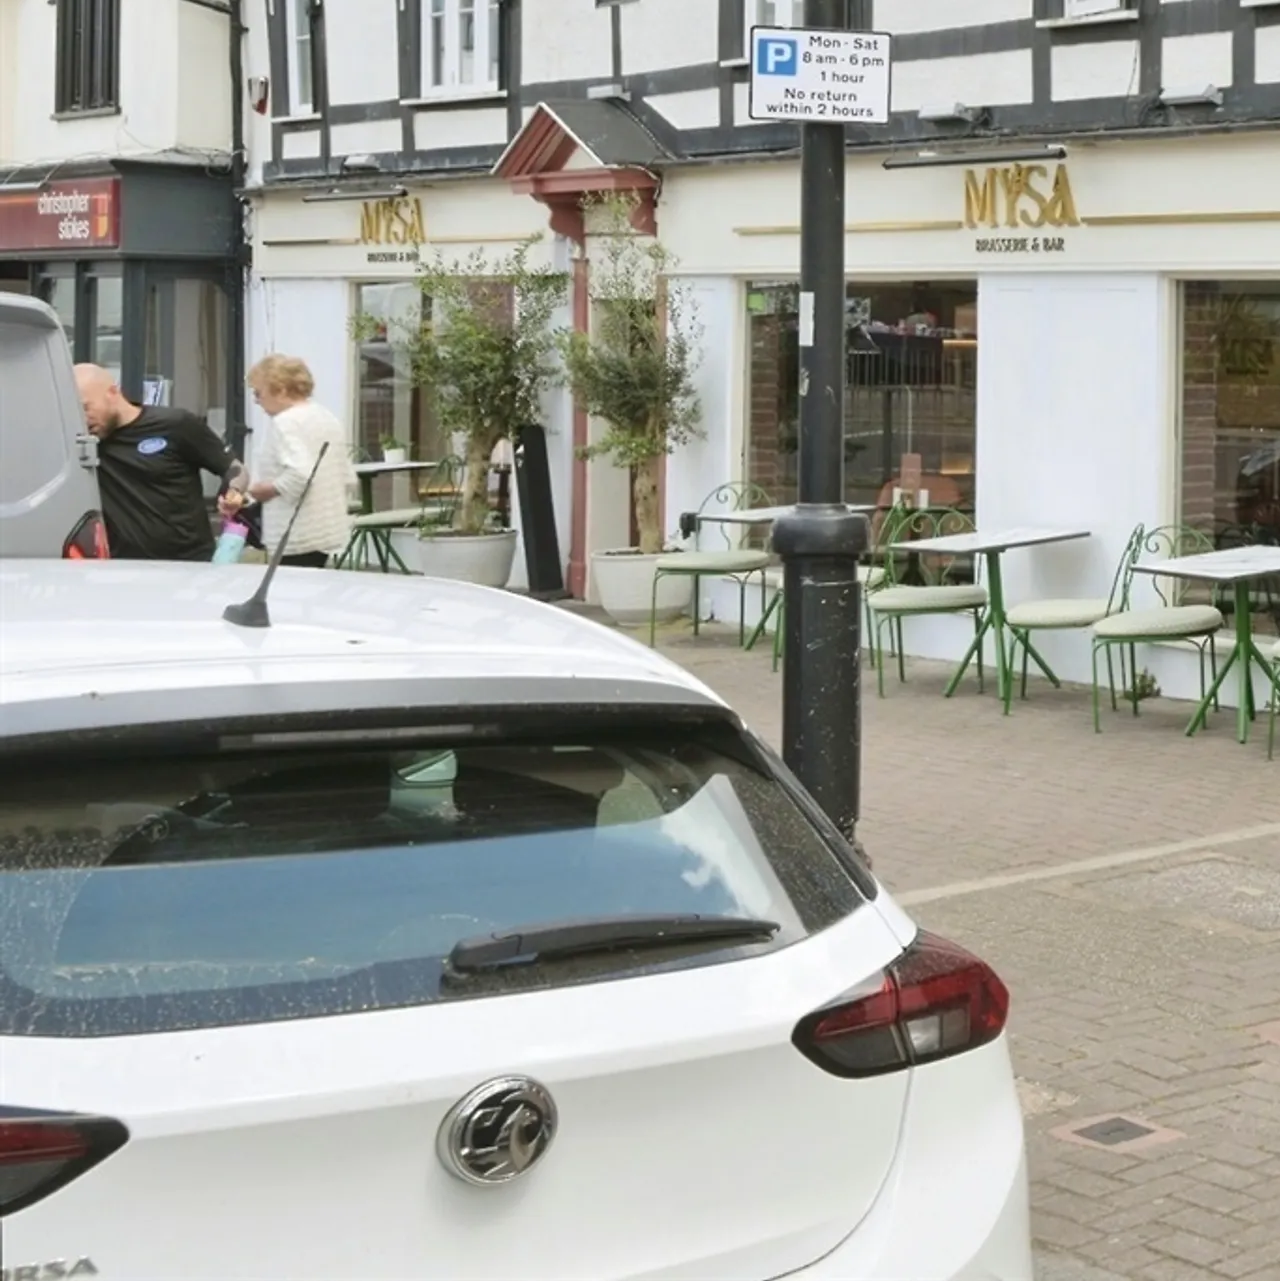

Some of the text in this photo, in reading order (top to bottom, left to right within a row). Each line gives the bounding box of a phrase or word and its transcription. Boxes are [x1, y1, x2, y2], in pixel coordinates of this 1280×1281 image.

[809, 36, 841, 49] Mon
[853, 38, 879, 50] Sat
[767, 42, 792, 72] P
[802, 52, 812, 64] 8
[815, 55, 837, 64] am
[849, 55, 859, 66] 6
[862, 57, 884, 67] pm
[820, 71, 865, 84] 1 hour
[784, 88, 858, 102] No return
[766, 103, 874, 117] within 2 hours
[38, 188, 89, 218] christopher
[962, 163, 1081, 229] MYSA
[361, 198, 426, 245] MYSA
[976, 237, 1065, 252] BRASSERIE & BAR
